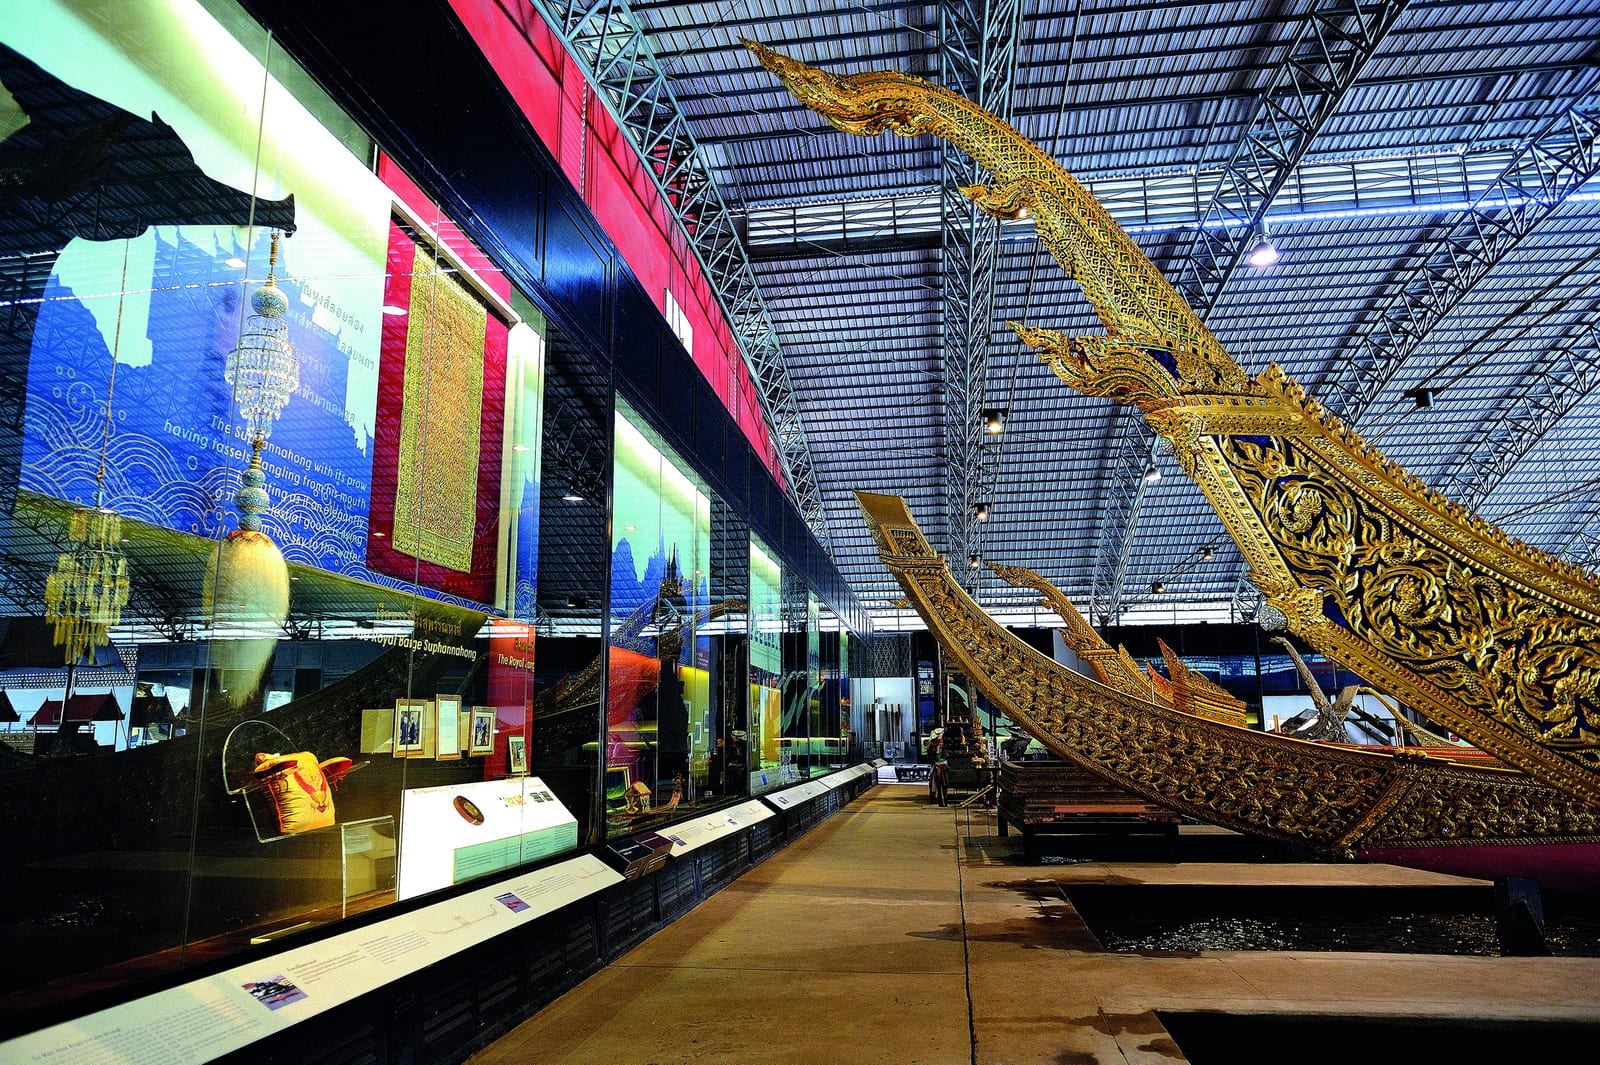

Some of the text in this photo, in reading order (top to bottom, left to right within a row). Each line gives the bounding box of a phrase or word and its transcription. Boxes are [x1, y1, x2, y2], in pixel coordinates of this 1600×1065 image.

[163, 418, 209, 450] having
[211, 438, 251, 463] tassels
[302, 474, 324, 493] from
[325, 484, 339, 498] his
[339, 491, 367, 510] mouth
[211, 414, 368, 491] The Supannahong with its prow
[272, 525, 290, 541] the
[292, 533, 307, 548] sky
[308, 538, 318, 549] to
[370, 630, 397, 647] Royal
[398, 636, 423, 653] Barge
[423, 638, 477, 662] Suphannahong
[497, 653, 508, 665] The
[508, 655, 525, 669] Royal
